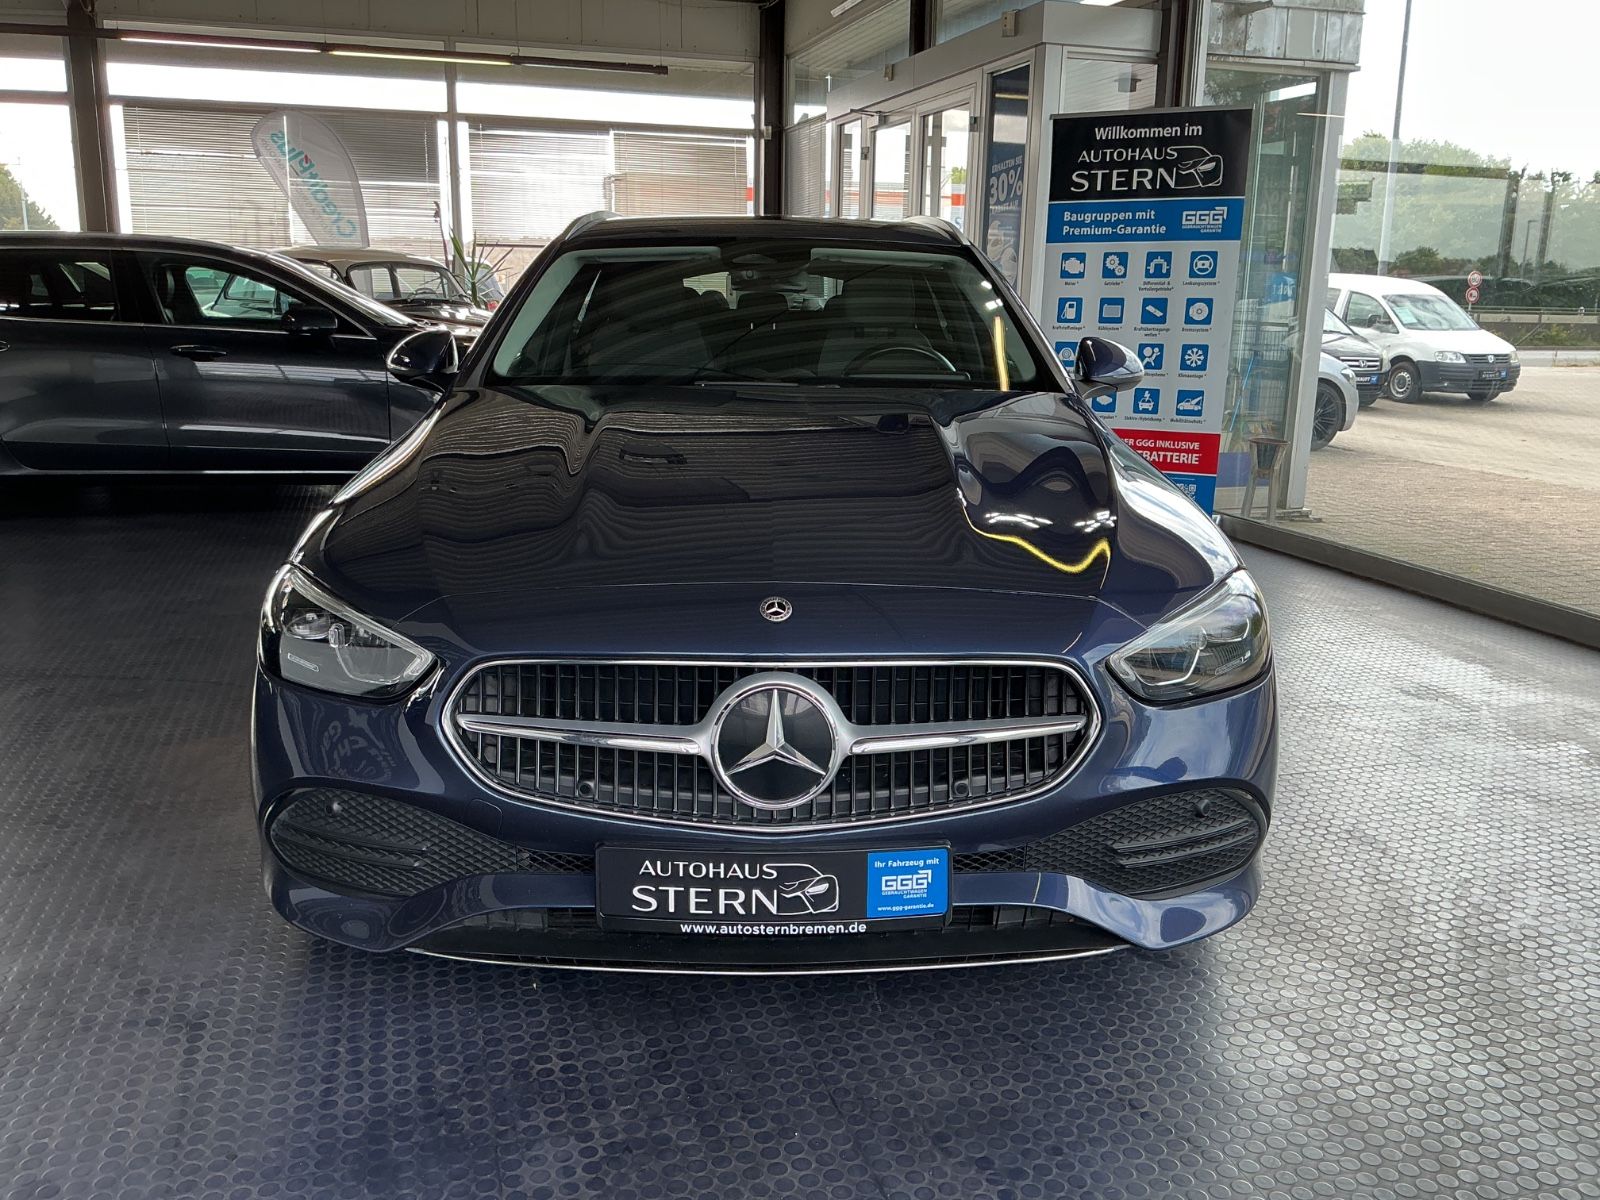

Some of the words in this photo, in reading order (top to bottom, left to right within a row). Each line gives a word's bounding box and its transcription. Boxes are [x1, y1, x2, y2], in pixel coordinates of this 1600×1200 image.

[1095, 124, 1181, 140] Willkommen
[1185, 123, 1202, 136] im
[1078, 147, 1178, 163] AUTOHAUS
[989, 167, 1023, 205] 30%
[1070, 167, 1177, 192] STERN
[1063, 211, 1133, 225] Baugruppen
[1135, 209, 1155, 220] mit
[1182, 208, 1226, 225] GGG
[1062, 224, 1166, 236] Premium-Garantie
[1136, 439, 1155, 447] GGG
[1156, 440, 1200, 450] INKLUSIVE
[638, 860, 778, 880] AUTOHAUS
[874, 860, 886, 868] Ihr
[888, 860, 924, 868] Fahrzeug
[926, 857, 940, 865] mit
[881, 870, 932, 891] GGG
[631, 885, 778, 915] STERN
[877, 902, 935, 912] www.ggg-garantie.de
[680, 922, 867, 935] www.autosternbremen.de
